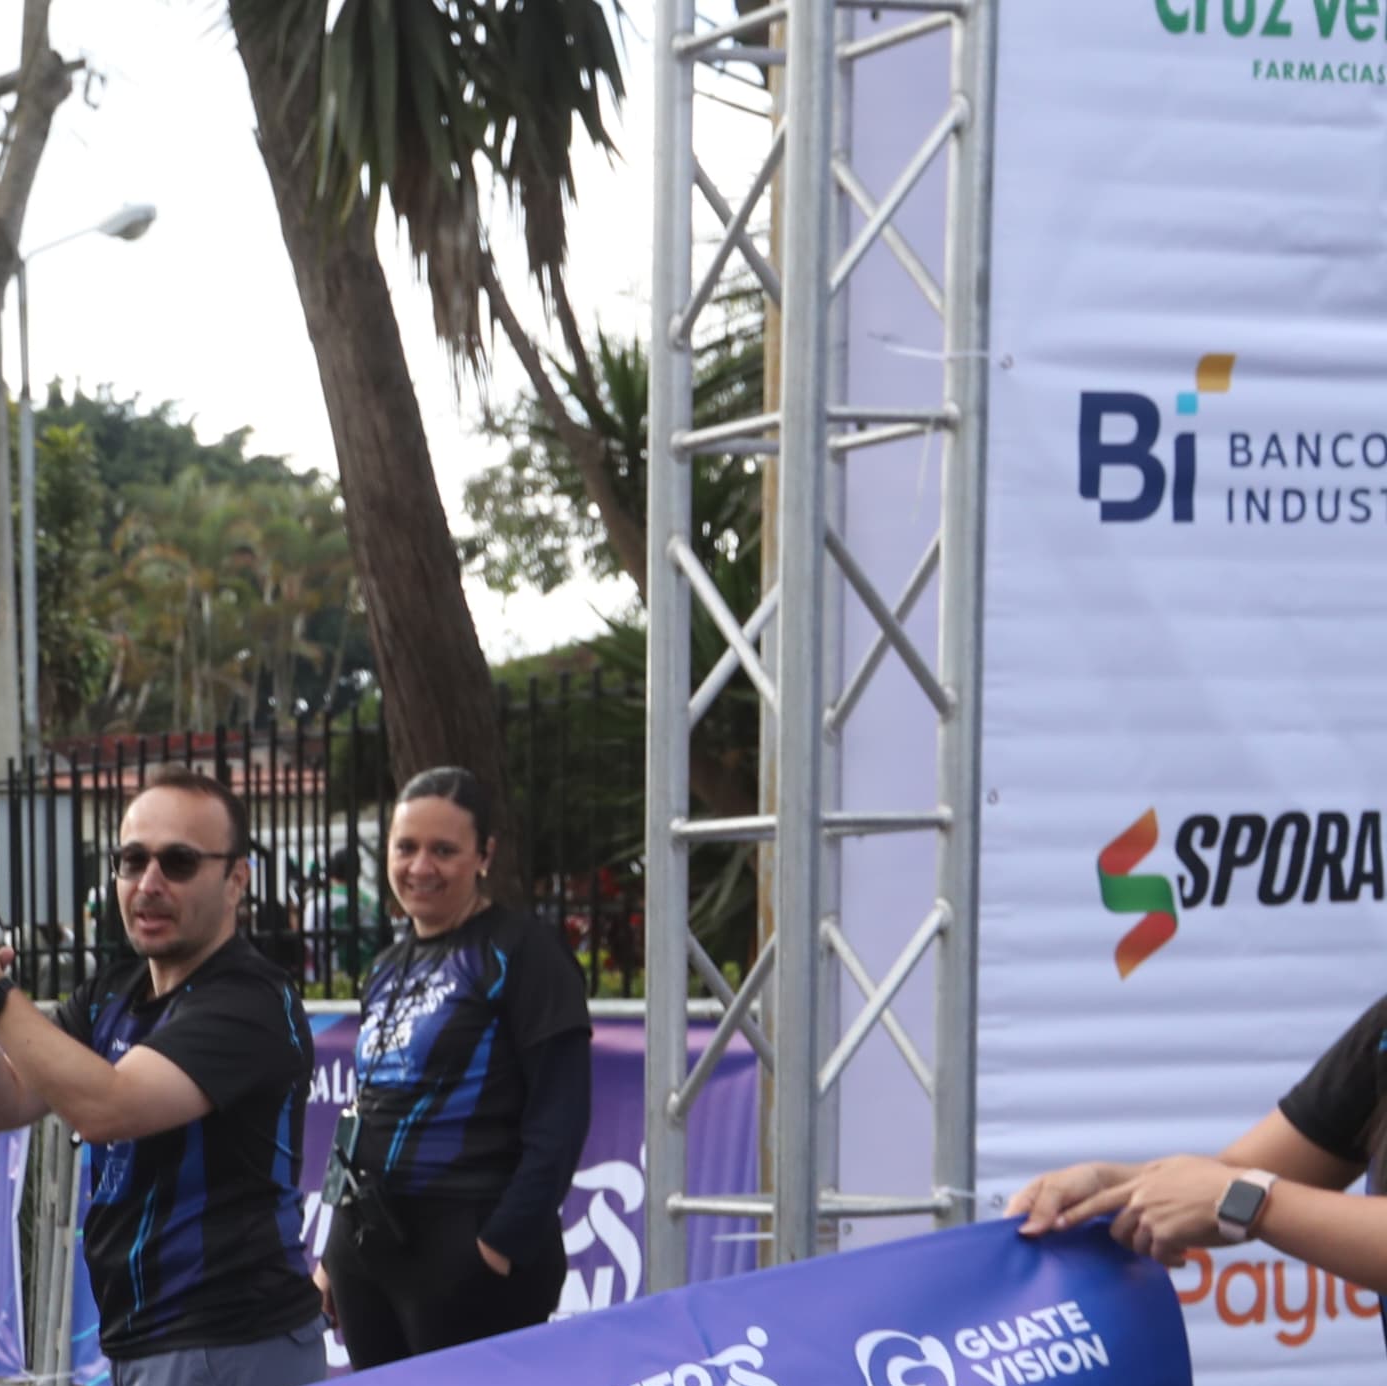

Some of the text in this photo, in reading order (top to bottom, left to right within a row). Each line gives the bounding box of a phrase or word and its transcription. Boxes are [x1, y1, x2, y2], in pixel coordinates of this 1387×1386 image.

[1253, 60, 1386, 85] FARMACIAS
[1230, 432, 1387, 469] BANCO
[955, 1300, 1091, 1358] GUATE
